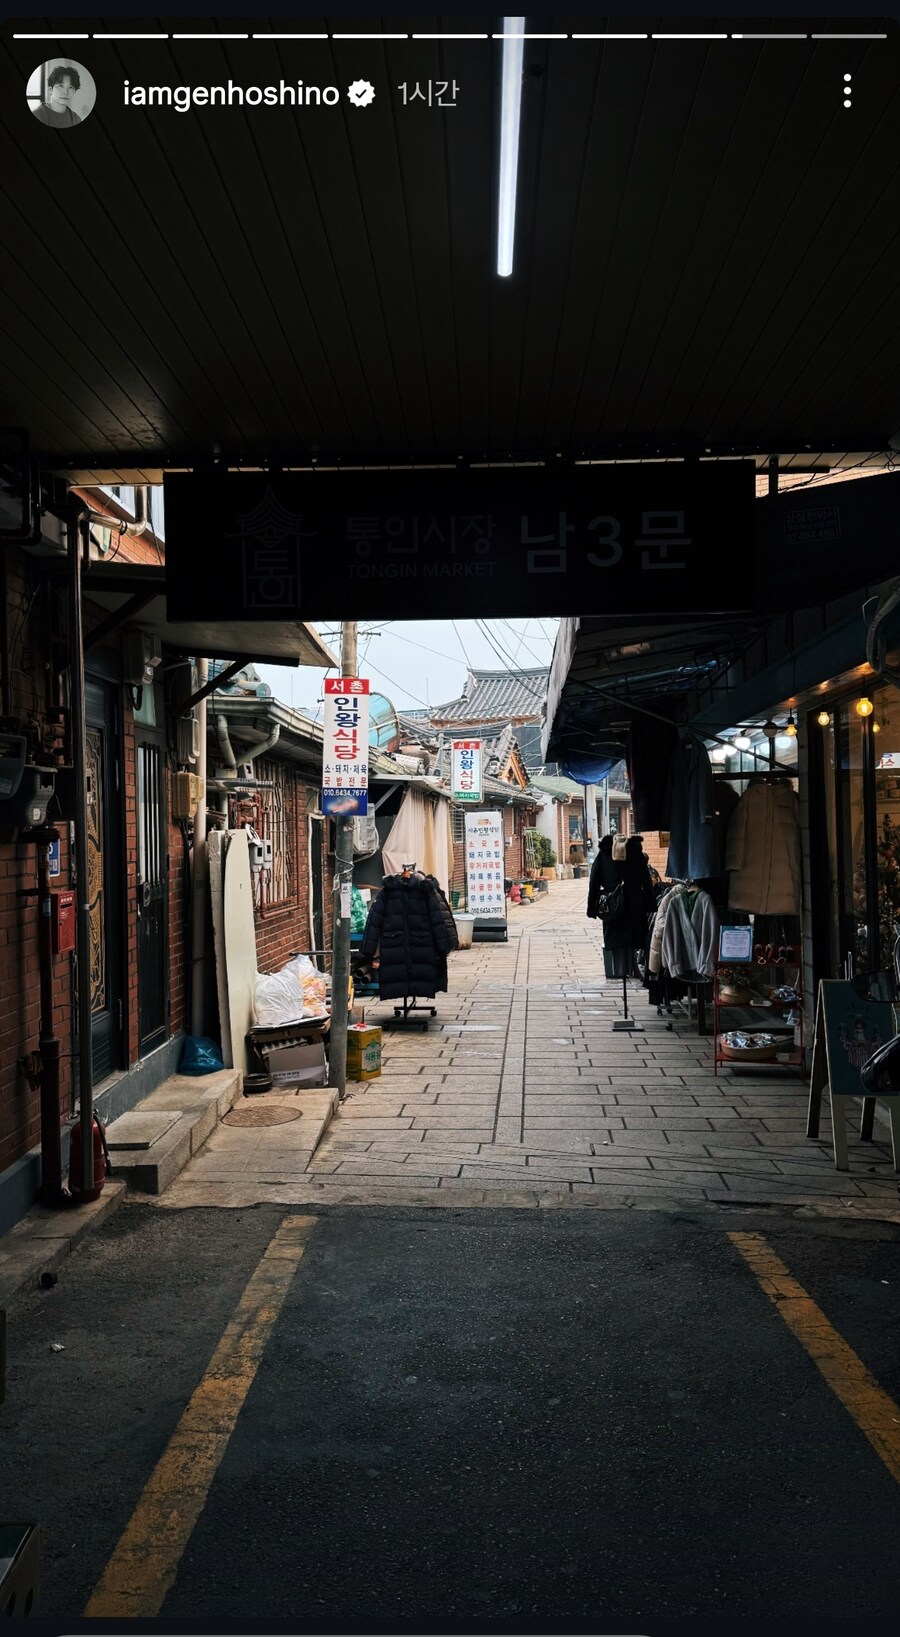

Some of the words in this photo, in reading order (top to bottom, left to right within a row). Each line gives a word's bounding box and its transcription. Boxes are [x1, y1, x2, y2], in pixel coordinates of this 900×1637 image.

[345, 514, 497, 558] 통인시장
[345, 561, 417, 579] TONGIN
[424, 560, 497, 577] MARKET
[330, 680, 364, 693] 서촌
[332, 697, 361, 760] 인왕식당
[459, 750, 475, 790] 인왕식당
[323, 789, 367, 797] 010.6434.7677
